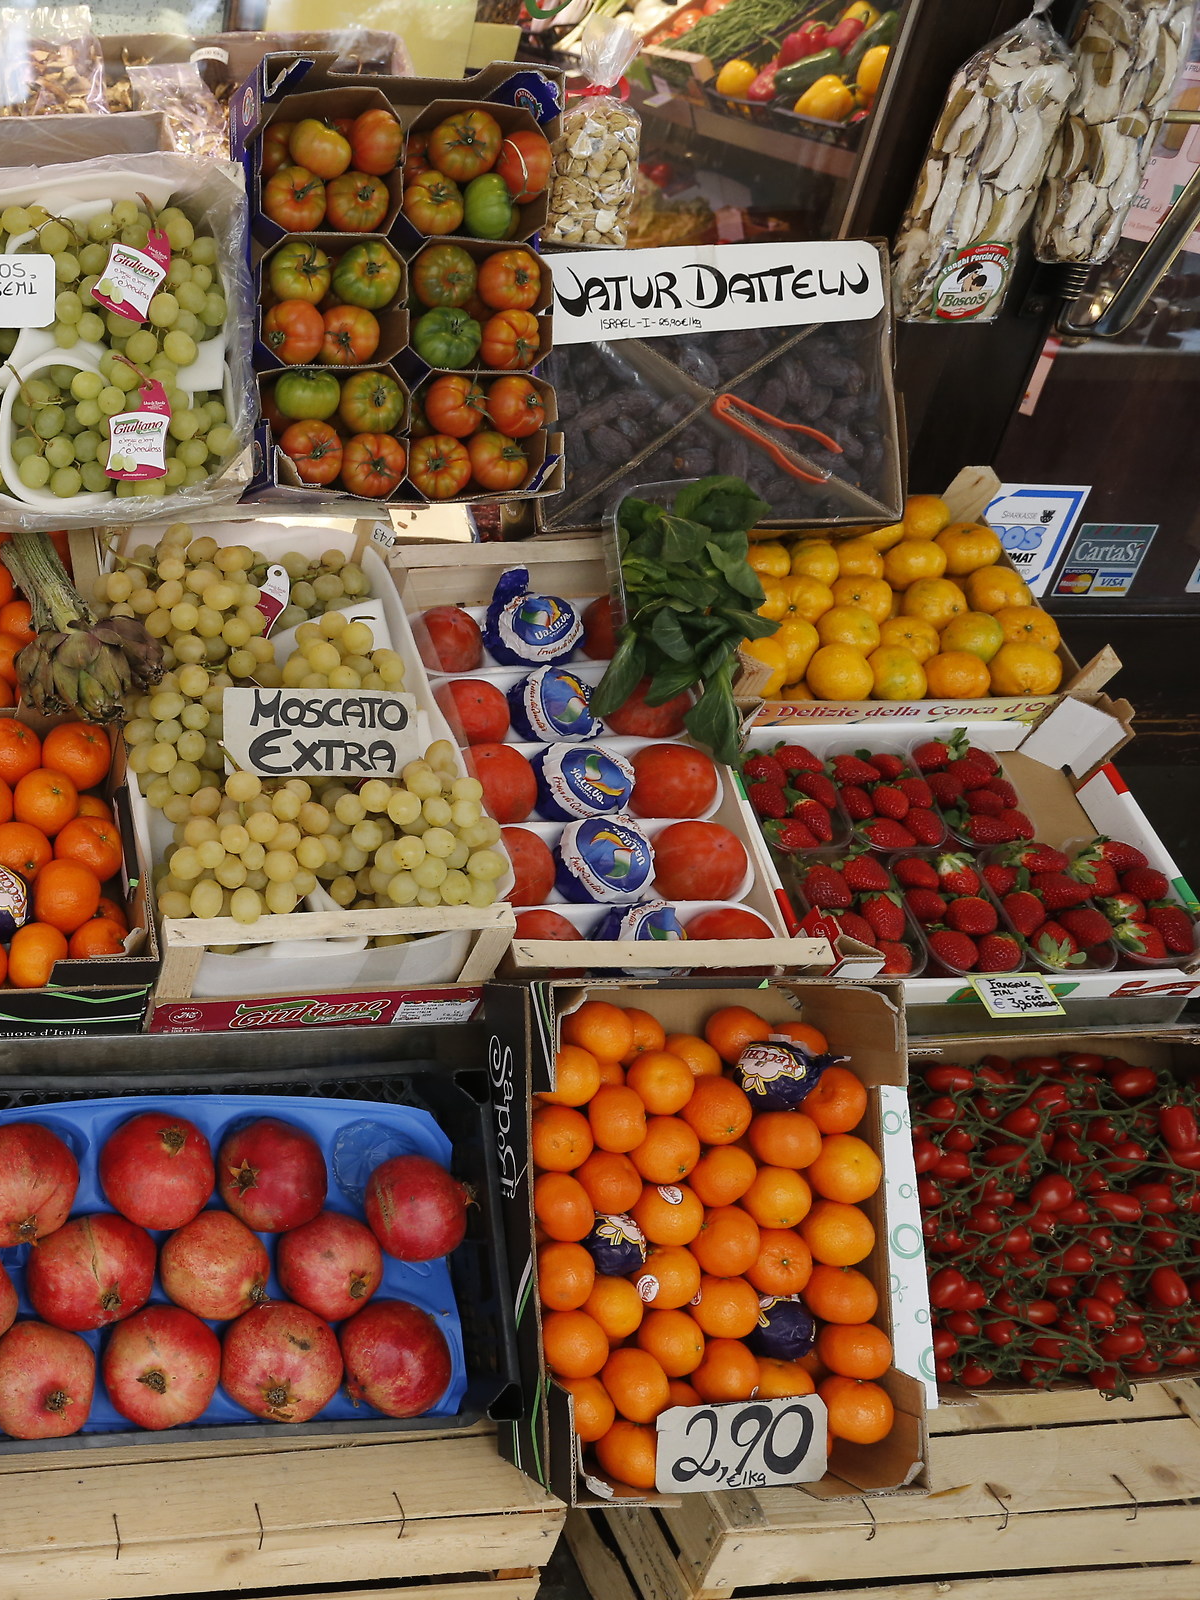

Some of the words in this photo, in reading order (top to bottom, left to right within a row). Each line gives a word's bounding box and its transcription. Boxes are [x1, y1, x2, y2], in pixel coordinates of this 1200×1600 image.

[112, 253, 160, 278] Giuliano
[545, 266, 683, 317] NATUR
[682, 262, 870, 310] DATTELN
[113, 420, 164, 435] Giuliano
[1001, 510, 1038, 520] SPARKASSE
[1100, 578, 1125, 587] VISA
[249, 688, 409, 732] MOSCATO
[776, 705, 859, 718] Delizie
[864, 705, 921, 717] della
[926, 704, 999, 716] Conca
[1003, 701, 1050, 715] d'O
[248, 728, 397, 774] EXTRA
[229, 999, 392, 1029] Giuliano
[40, 1026, 88, 1037] d'Italia
[741, 1049, 801, 1076] RECCHI
[671, 1404, 814, 1483] 2,90
